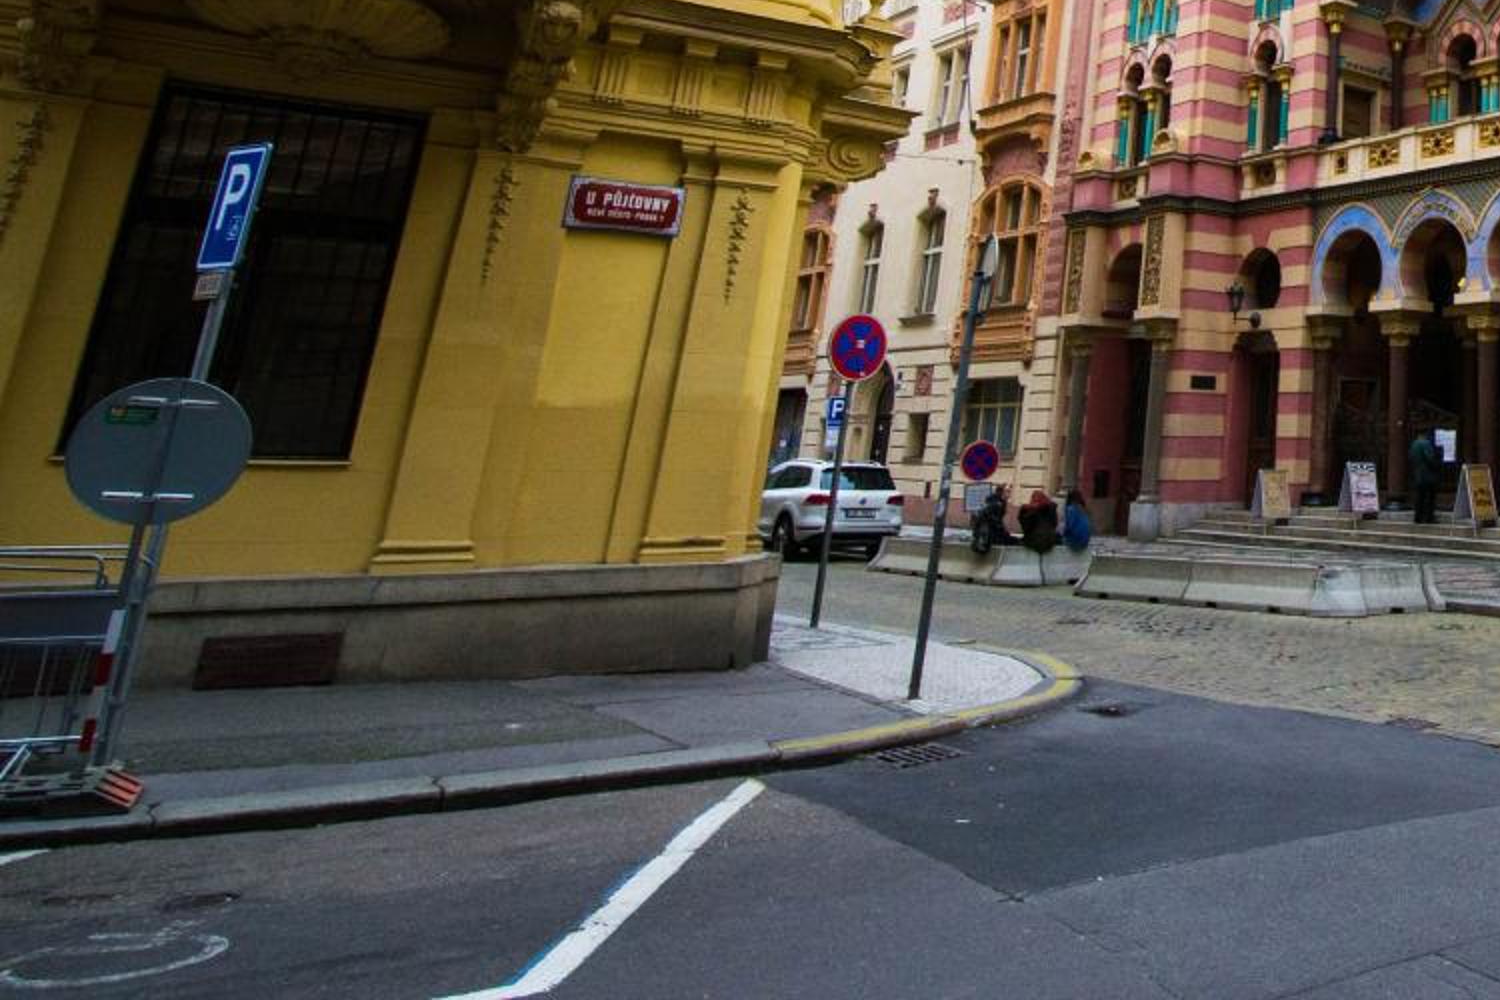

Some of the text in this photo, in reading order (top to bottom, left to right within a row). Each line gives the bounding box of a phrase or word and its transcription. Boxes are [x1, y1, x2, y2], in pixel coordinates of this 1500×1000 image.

[216, 163, 251, 230] P
[586, 191, 596, 205] U
[832, 400, 845, 418] P
